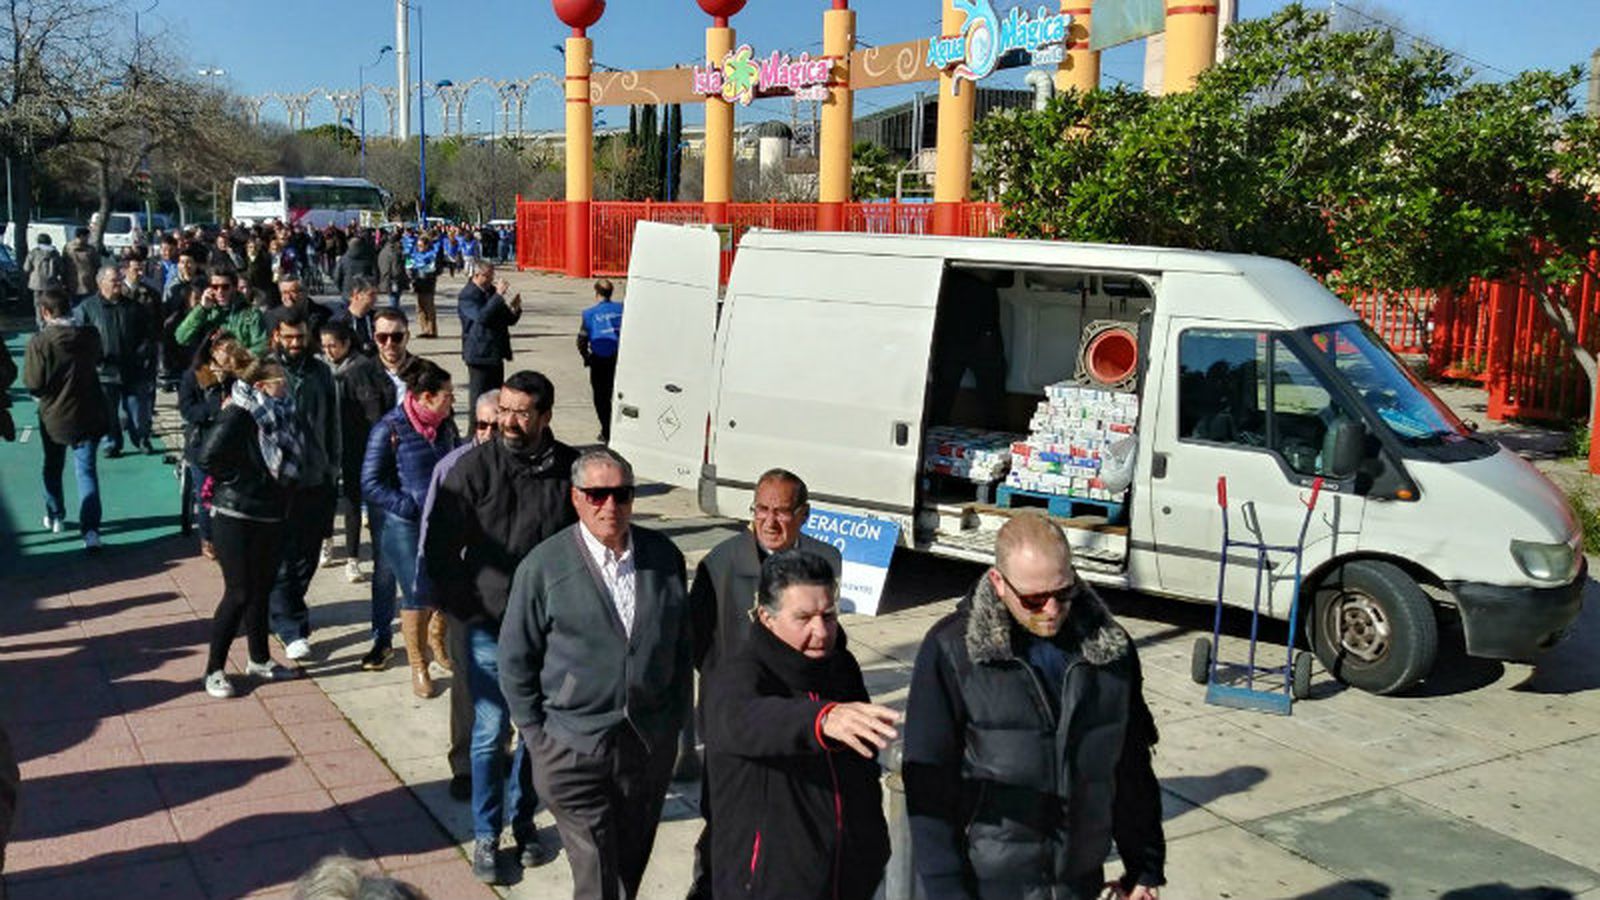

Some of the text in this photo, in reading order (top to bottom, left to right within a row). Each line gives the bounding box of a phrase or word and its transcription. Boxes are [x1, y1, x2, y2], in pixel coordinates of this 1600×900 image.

[925, 6, 1066, 68] Agua Mágica
[692, 50, 830, 94] Isla Mágica
